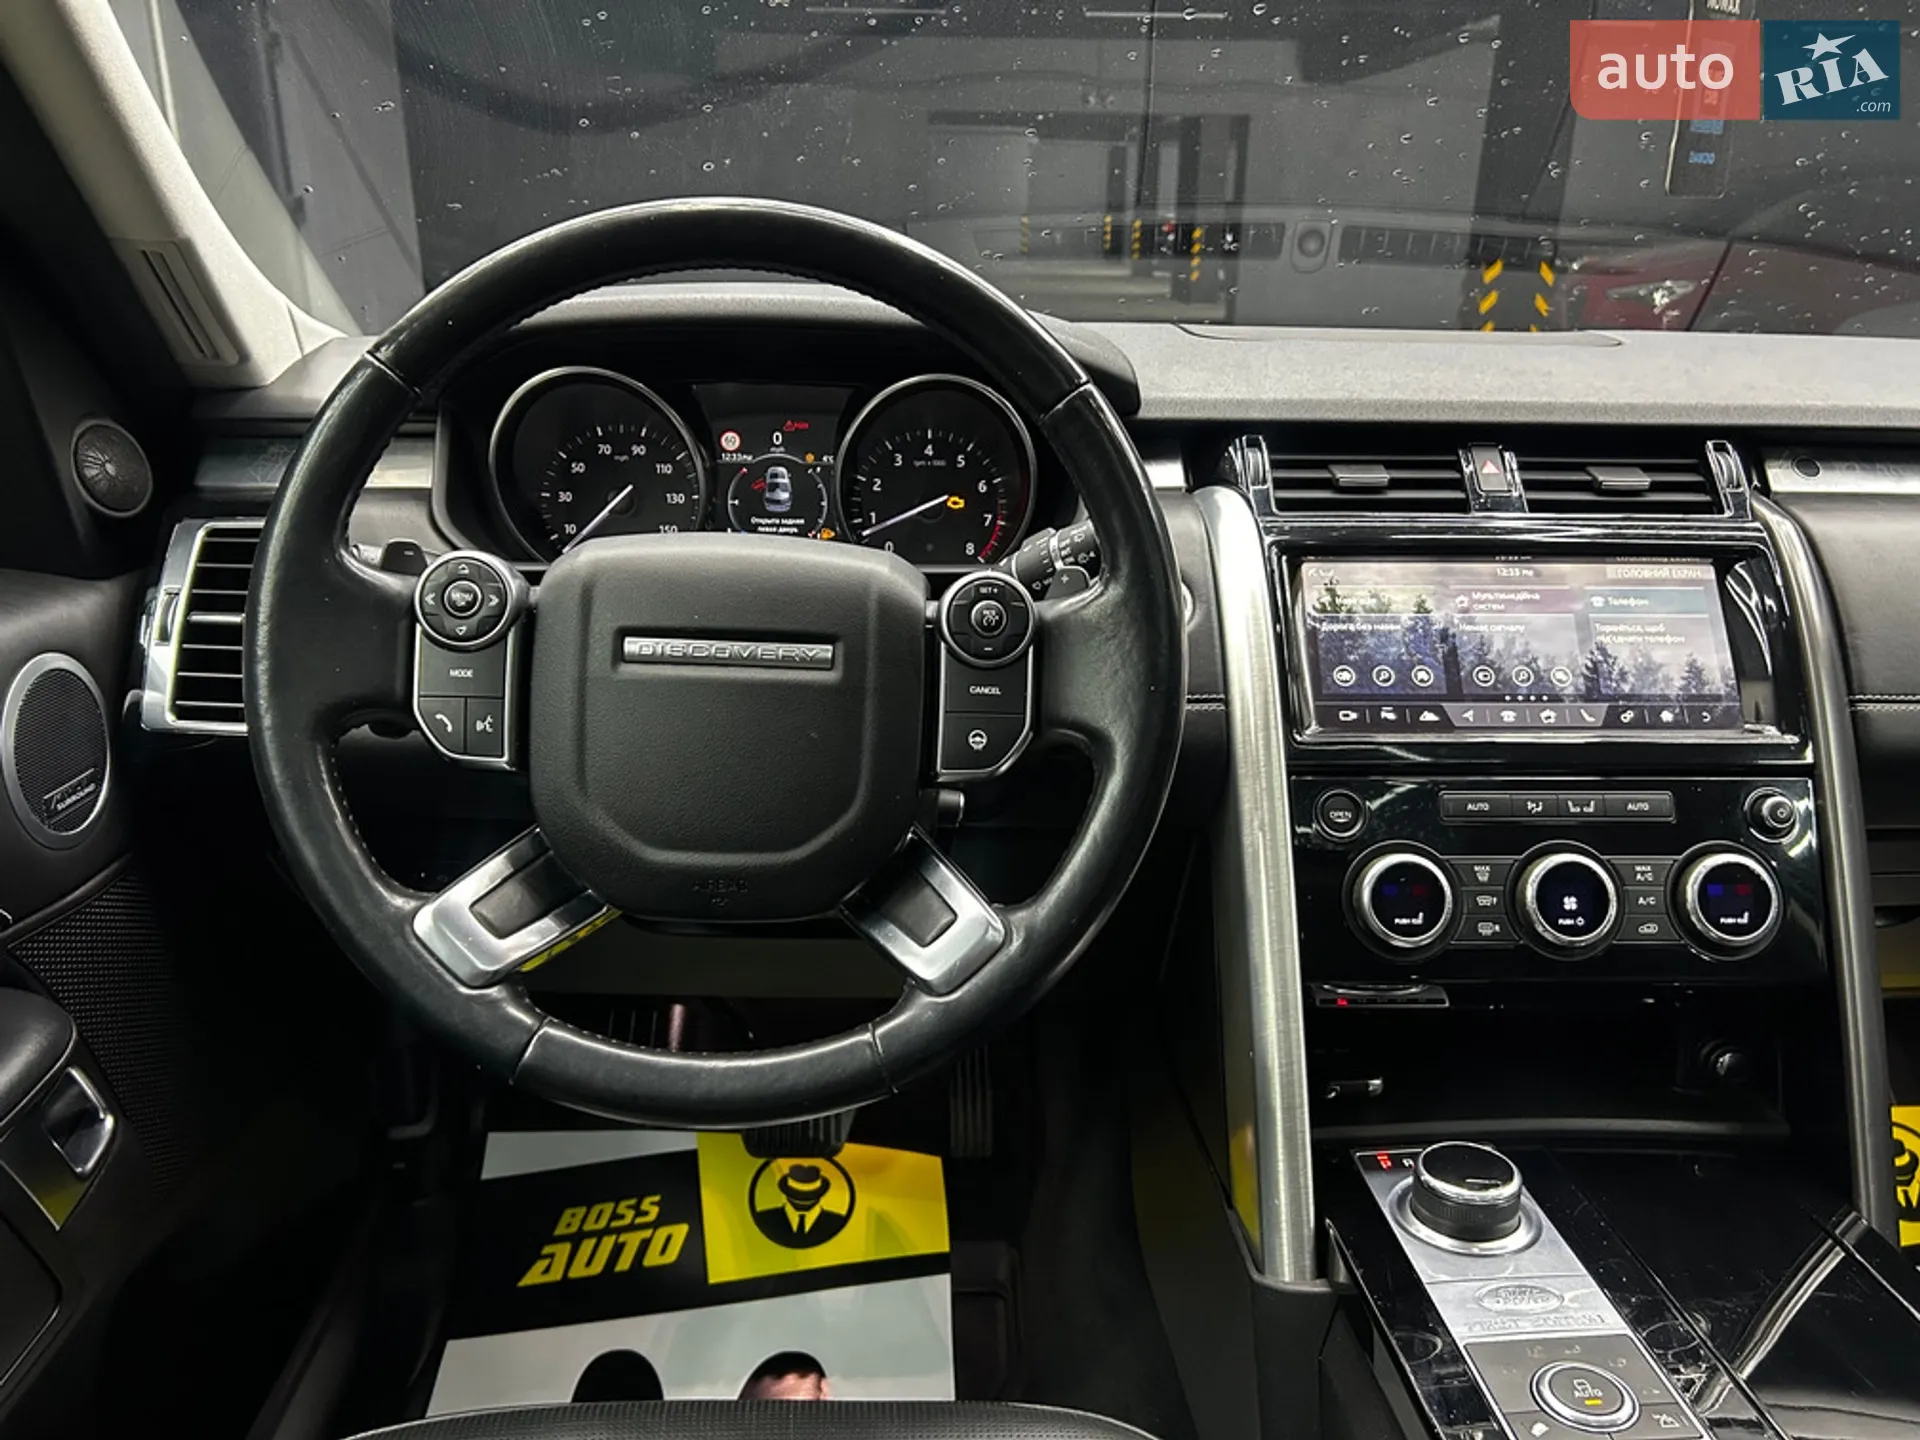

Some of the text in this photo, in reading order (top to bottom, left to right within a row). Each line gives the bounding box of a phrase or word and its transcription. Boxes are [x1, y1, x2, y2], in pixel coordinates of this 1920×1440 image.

[772, 431, 783, 446] 0
[597, 444, 612, 455] 70
[631, 444, 647, 456] 90
[924, 444, 933, 456] 4
[893, 453, 903, 467] 3
[956, 454, 966, 468] 5
[570, 462, 586, 474] 50
[655, 463, 673, 475] 110
[872, 478, 882, 491] 2
[977, 480, 987, 493] 6
[557, 491, 573, 503] 30
[666, 493, 685, 504] 130
[869, 511, 876, 525] 1
[983, 514, 993, 527] 7
[564, 523, 577, 535] 10
[965, 543, 975, 556] 8
[634, 641, 821, 662] DISCOVERY
[450, 668, 473, 678] MODE
[969, 685, 1001, 695] CANCEL
[1466, 802, 1490, 812] AUTO
[1626, 802, 1650, 812] AUTO
[1635, 873, 1654, 882] A/C
[1637, 896, 1657, 906] A/C
[553, 1194, 661, 1236] BOSS
[516, 1222, 690, 1287] AUTO
